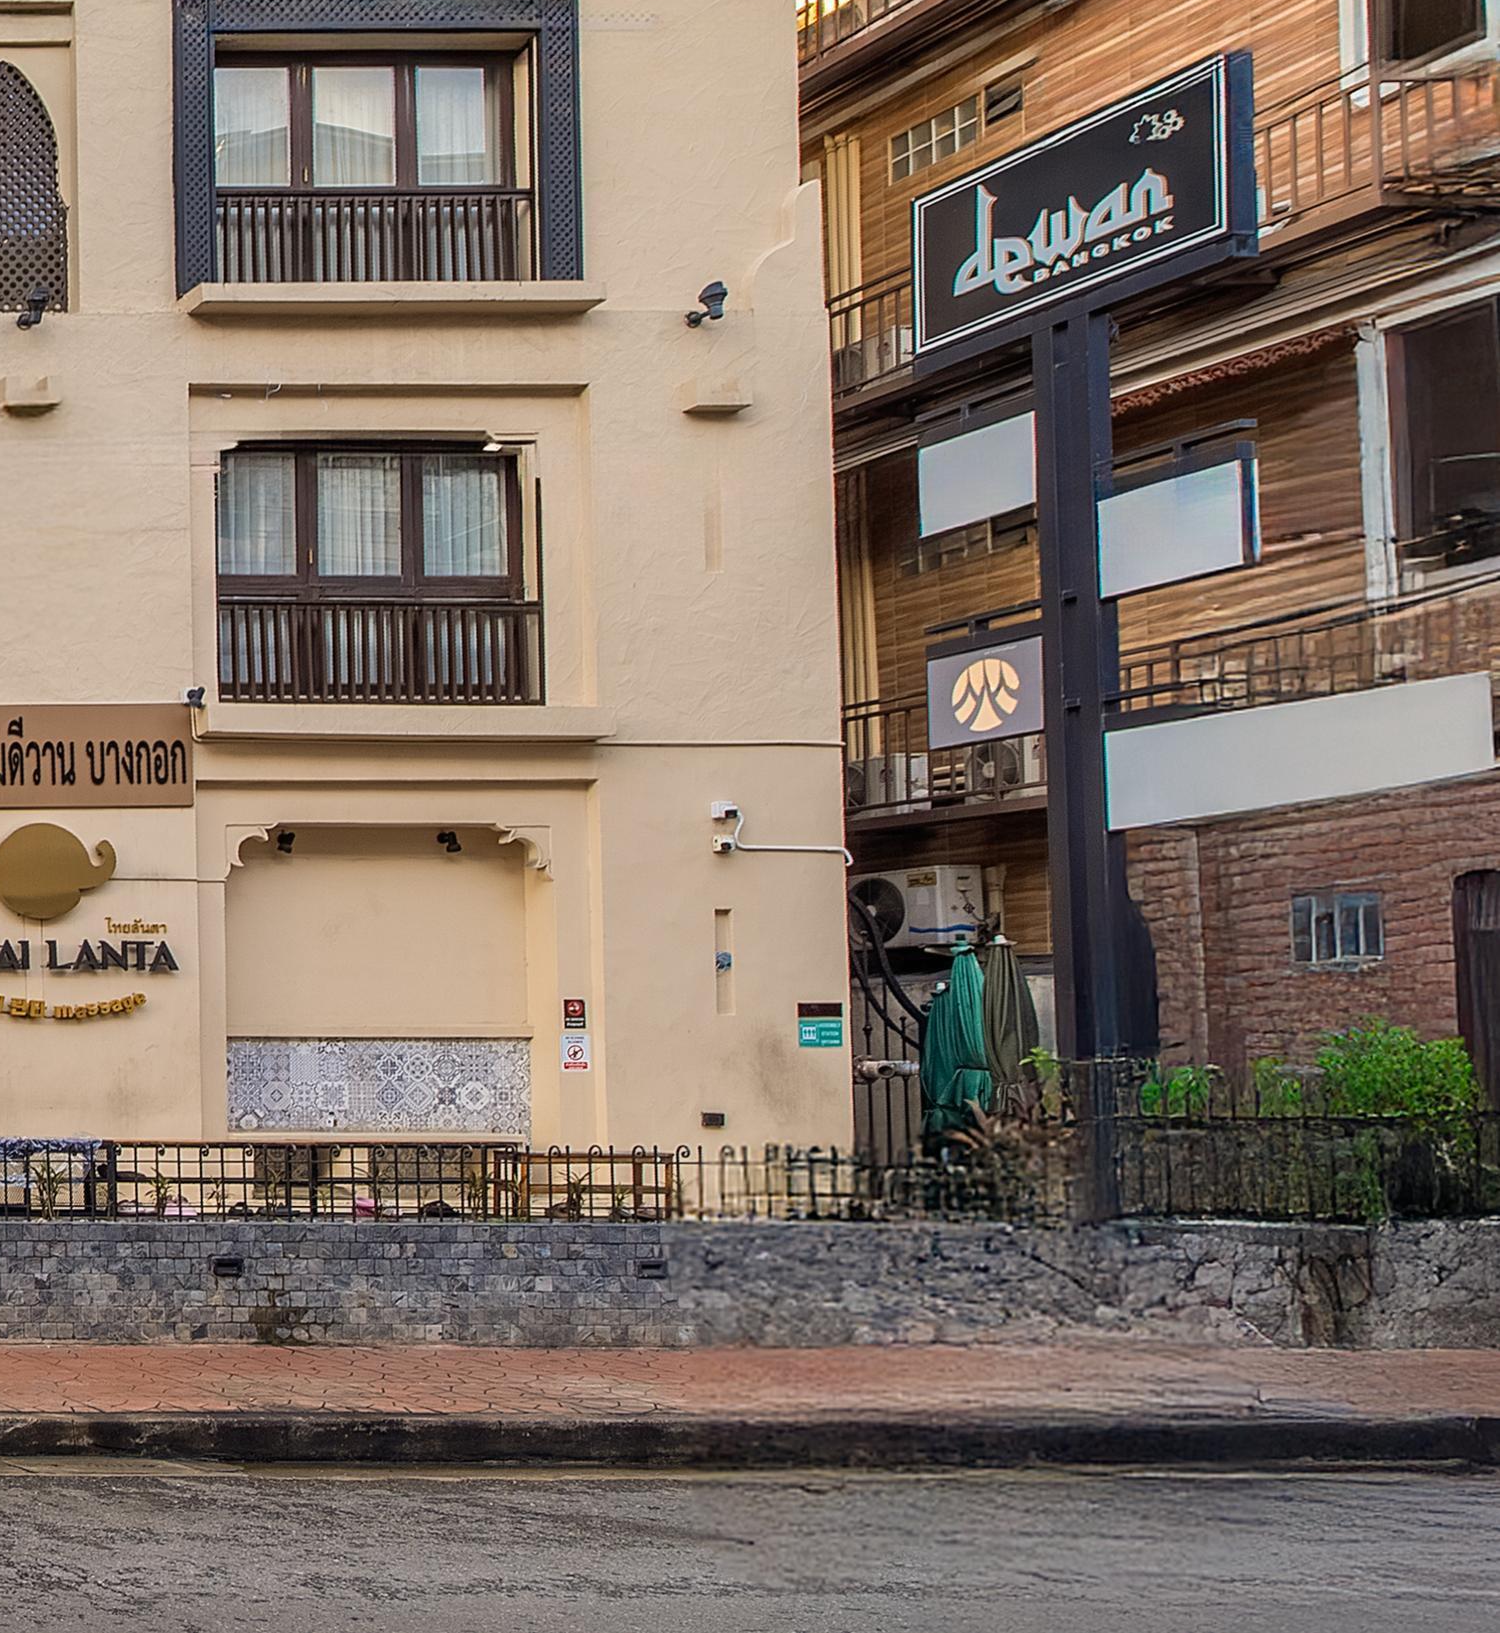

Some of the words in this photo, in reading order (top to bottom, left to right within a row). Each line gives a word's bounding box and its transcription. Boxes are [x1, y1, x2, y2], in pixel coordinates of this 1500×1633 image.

[953, 167, 1175, 298] dewan
[1034, 216, 1175, 284] BANGKOK
[86, 739, 187, 785] บางกอก
[105, 917, 167, 934] ไทยลันตา
[44, 939, 180, 971] LANTA
[53, 991, 148, 1020] massage
